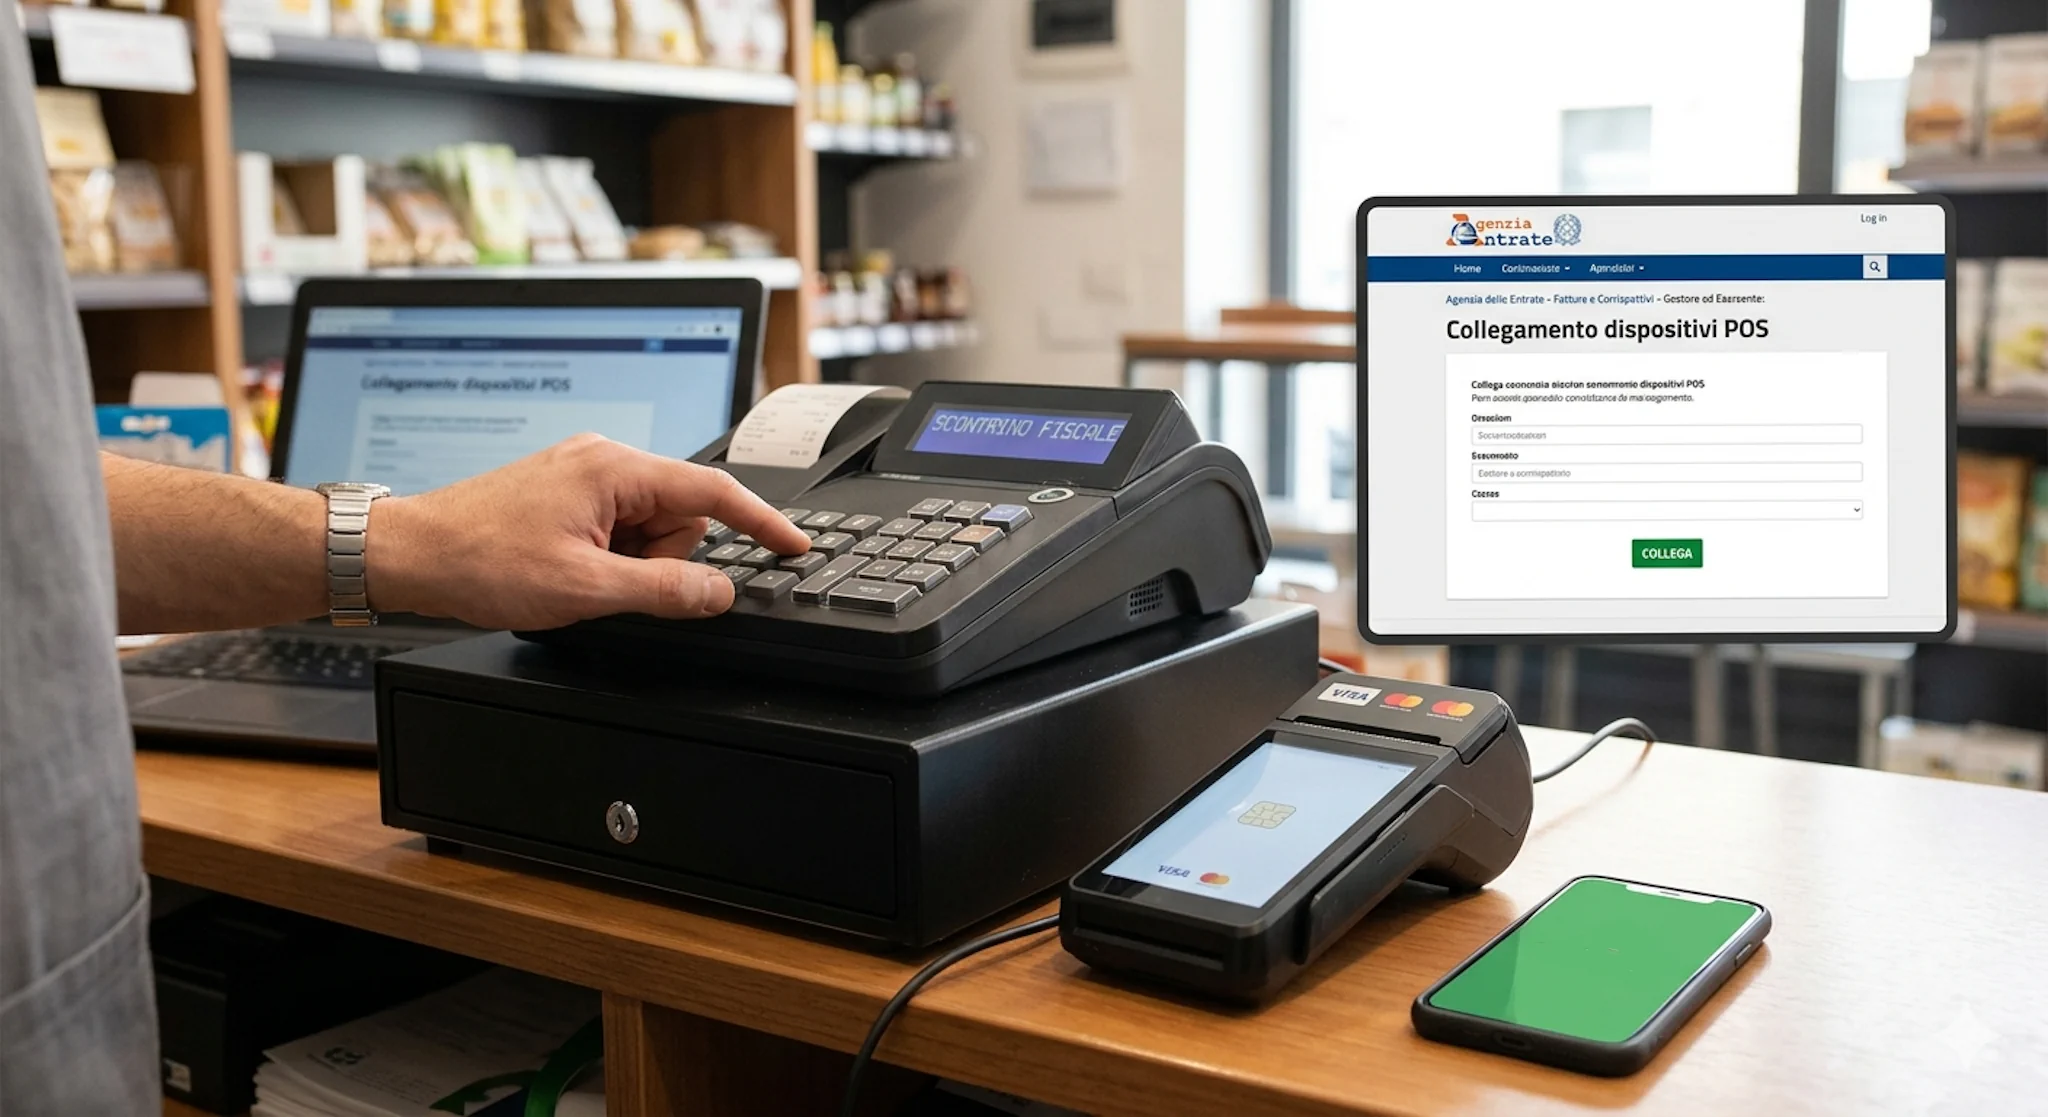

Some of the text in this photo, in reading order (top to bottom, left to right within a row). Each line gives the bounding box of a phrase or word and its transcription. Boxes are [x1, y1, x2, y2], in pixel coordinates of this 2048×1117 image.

[1861, 213, 1888, 225] Log in
[1453, 263, 1482, 274] Home
[1509, 294, 1545, 305] Entrate
[1553, 294, 1588, 305] Fatture
[1663, 293, 1701, 304] Gestore
[1446, 318, 1769, 345] Collegamento dispositivi POS
[1037, 419, 1127, 442] FISCALE
[1641, 547, 1693, 560] COLLEGA
